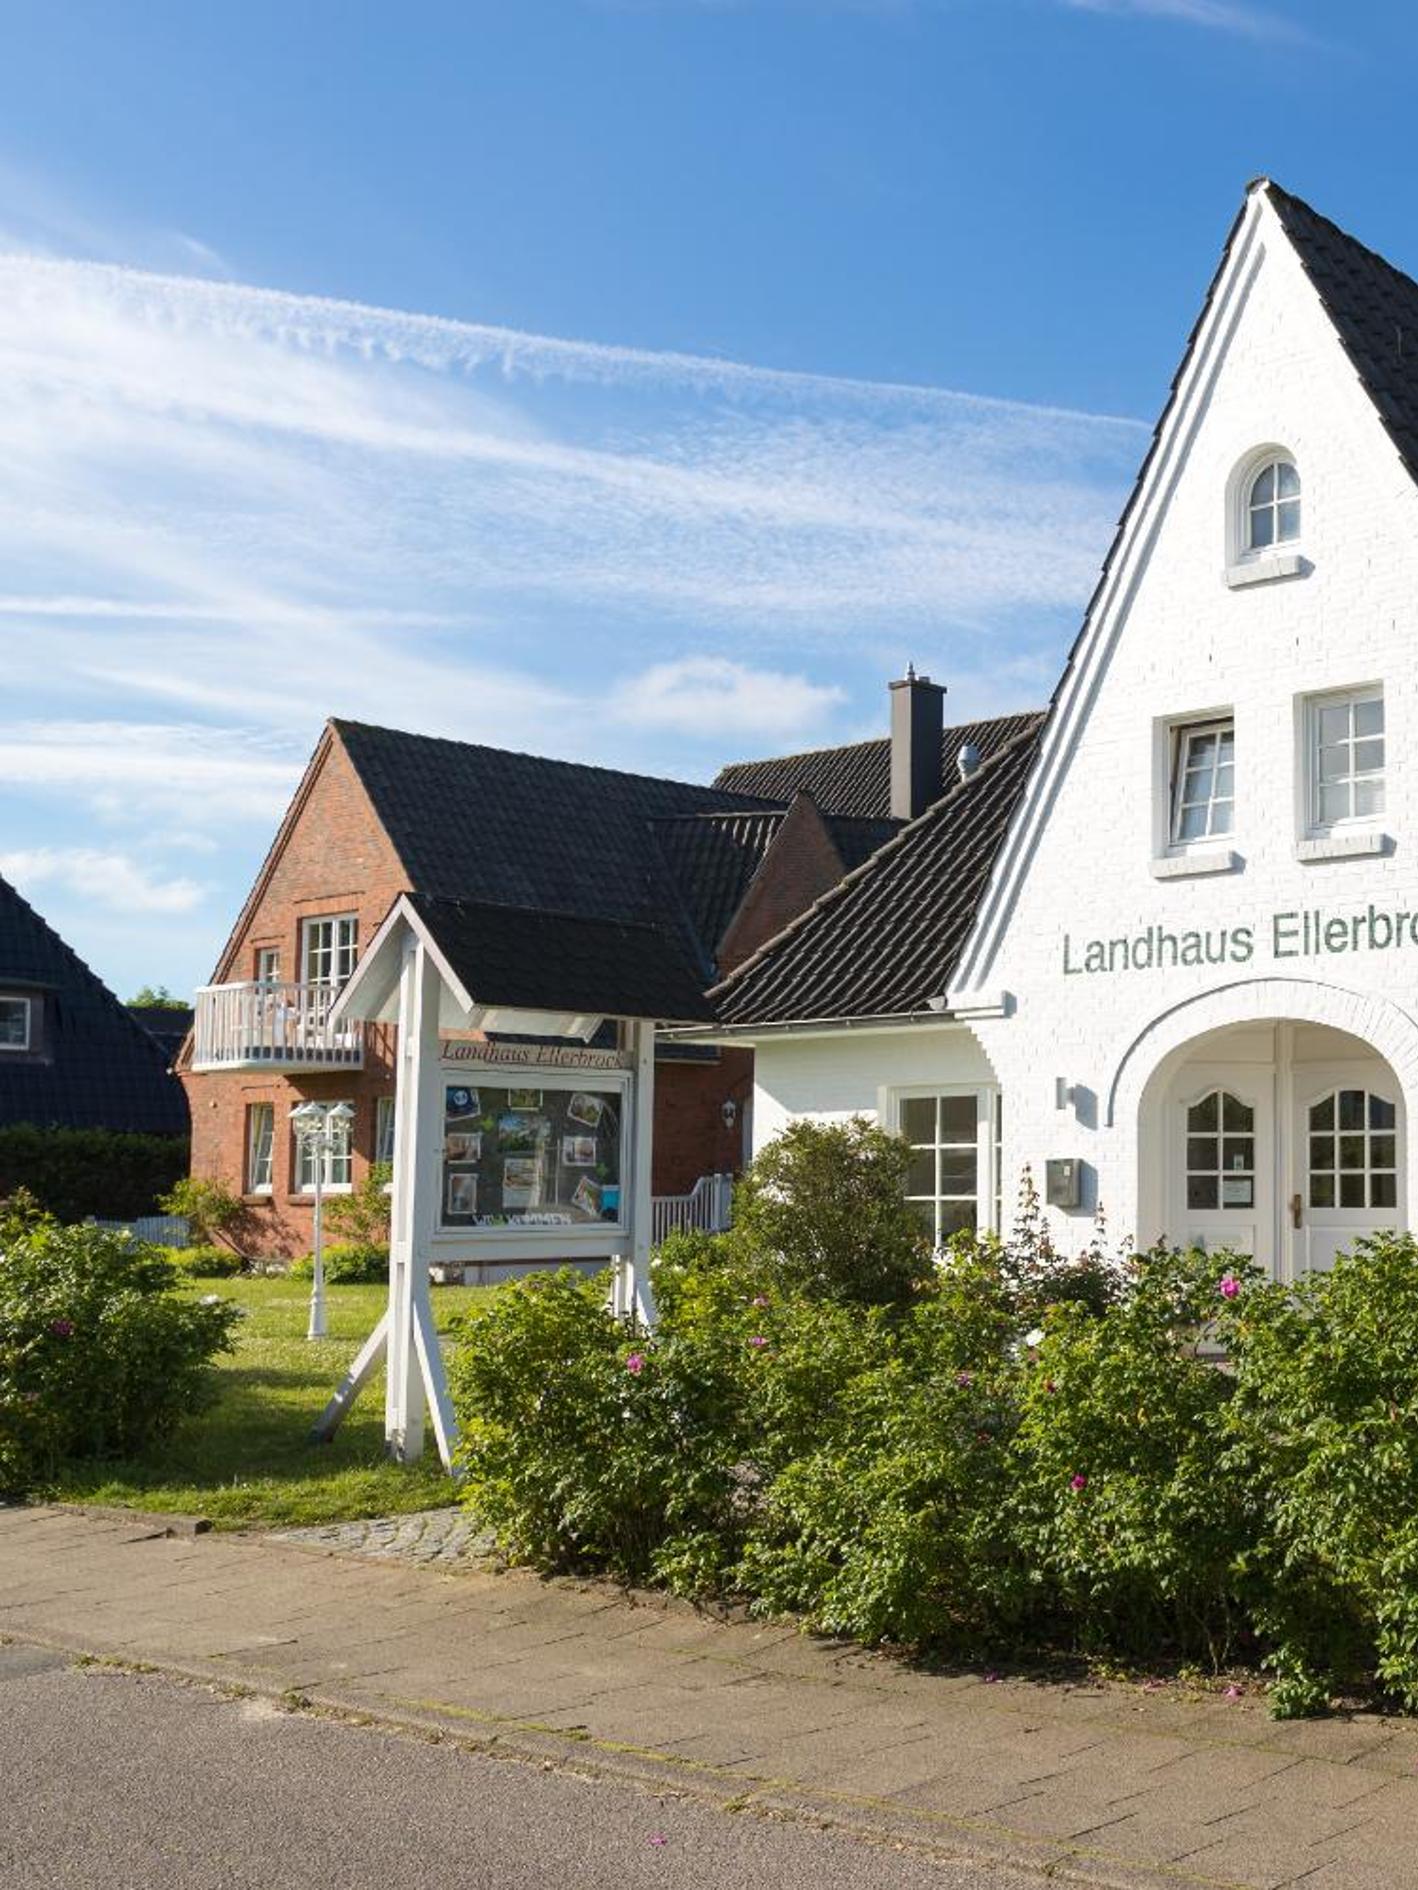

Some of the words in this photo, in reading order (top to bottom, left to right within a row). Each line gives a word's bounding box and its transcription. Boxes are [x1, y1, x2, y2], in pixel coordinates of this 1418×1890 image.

[1064, 925, 1254, 974] Landhaus
[437, 1039, 529, 1064] Landhaus
[537, 1045, 623, 1069] Ellerbrock
